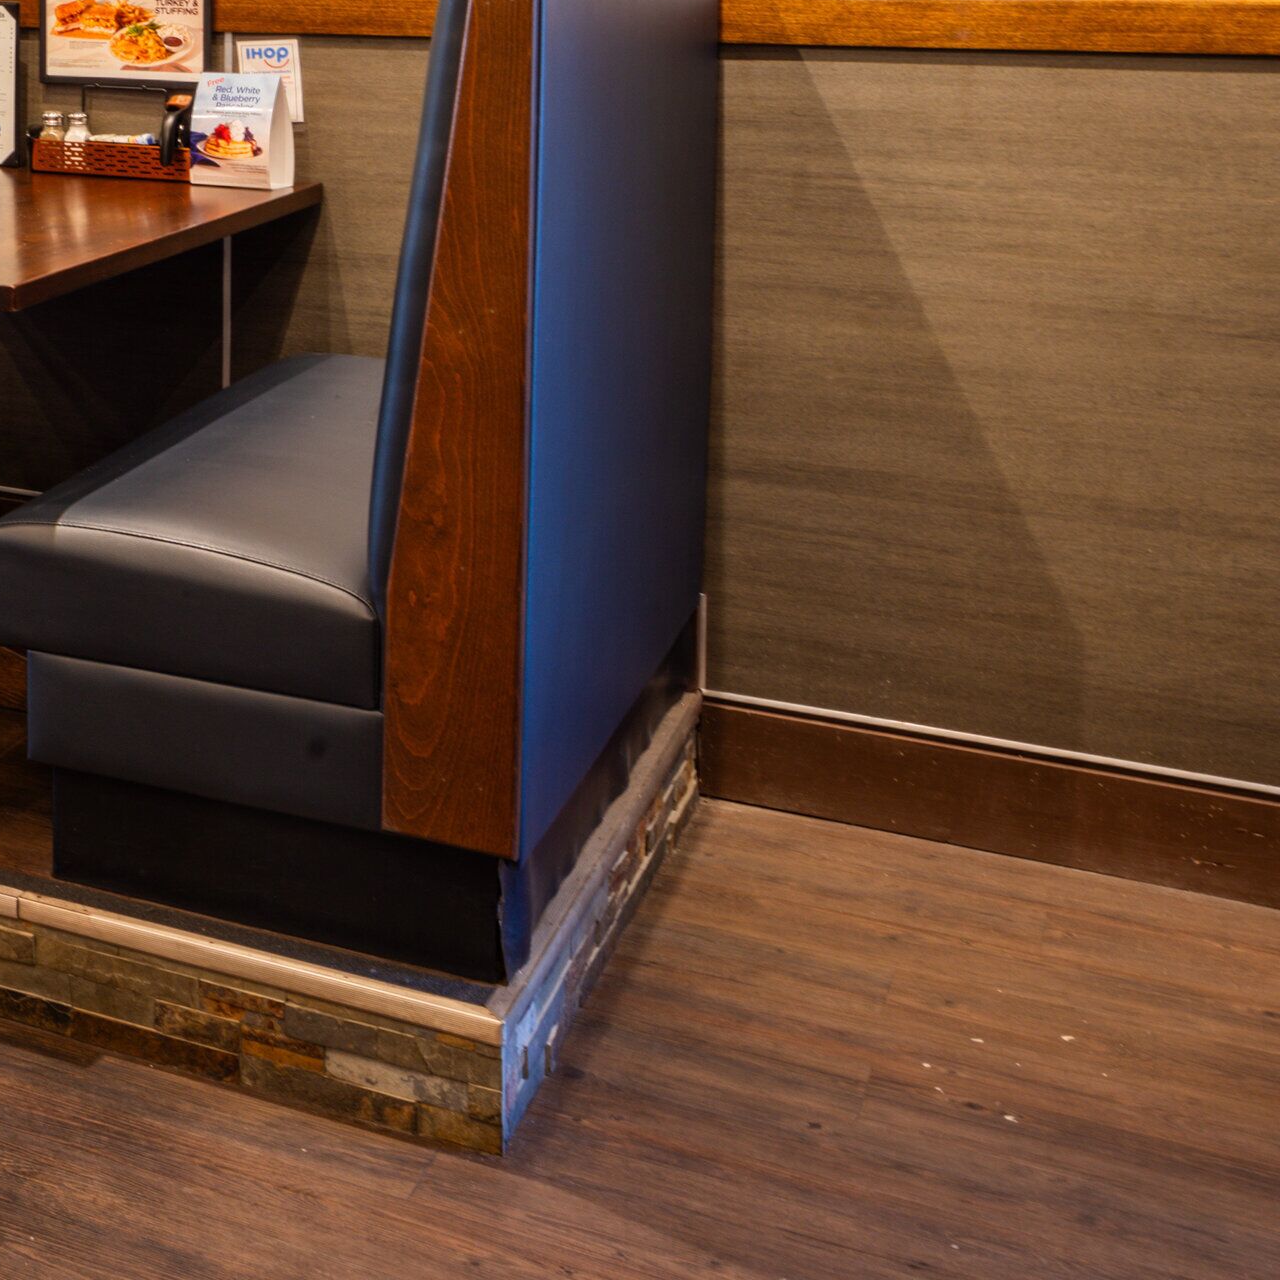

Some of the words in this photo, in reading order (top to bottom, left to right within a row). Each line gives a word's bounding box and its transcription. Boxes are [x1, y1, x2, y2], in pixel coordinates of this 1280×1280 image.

[155, 0, 189, 7] TURKEY
[155, 7, 199, 16] STUFFING
[246, 46, 289, 63] IHOP
[207, 77, 225, 87] Free
[215, 85, 233, 94] Red,
[236, 86, 261, 95] White
[220, 94, 261, 104] Blueberry
